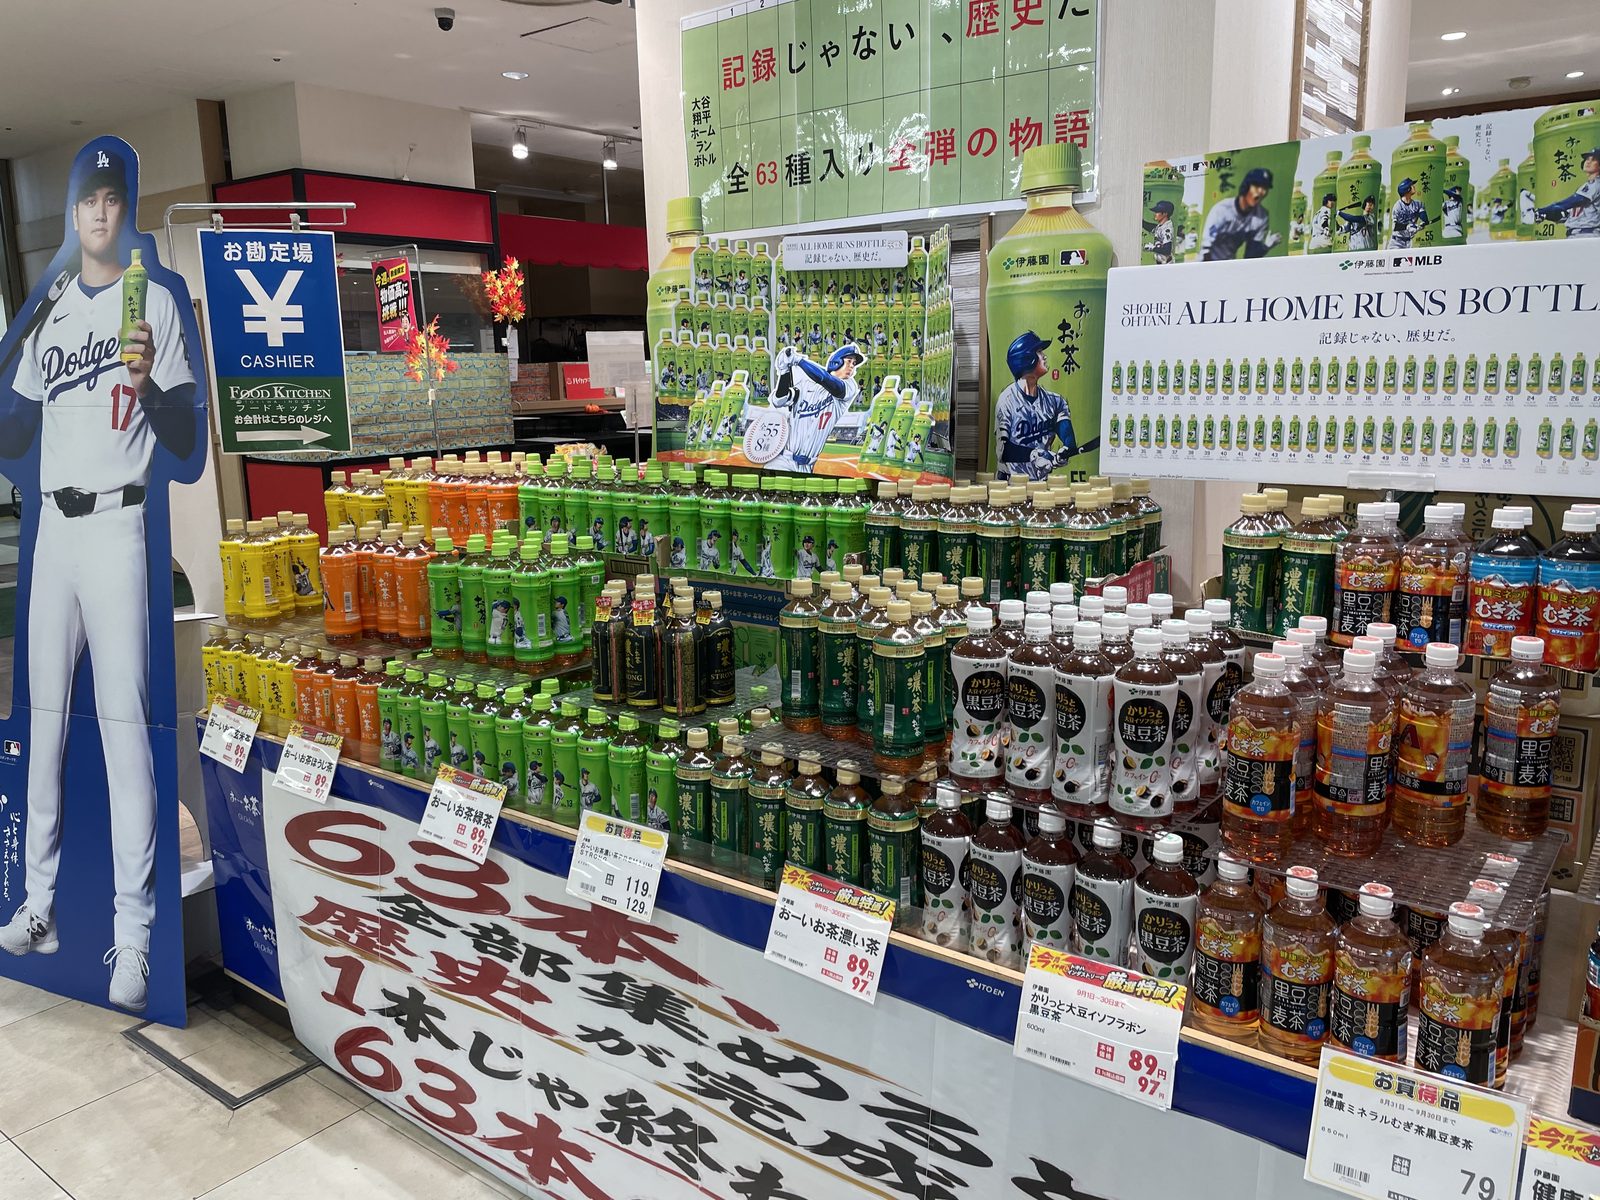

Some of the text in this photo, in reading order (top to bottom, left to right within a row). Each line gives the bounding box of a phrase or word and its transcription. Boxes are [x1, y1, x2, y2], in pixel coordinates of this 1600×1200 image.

[692, 96, 711, 111] 大谷
[692, 110, 711, 126] 翔平
[690, 125, 716, 139] ホーム
[696, 140, 713, 153] ラン
[693, 152, 717, 167] ボトル
[1543, 224, 1555, 237] 20
[223, 241, 314, 264] お勘定場
[1015, 254, 1050, 268] 伊藤園
[1354, 255, 1443, 269] 伊藤園 MLB
[1122, 302, 1172, 315] SHOHEI
[1176, 283, 1600, 325] ALL HOME RUNS BOTTL
[1121, 314, 1171, 327] OHTANI
[1318, 328, 1457, 345] 記録じゃない、歴史だ。
[42, 331, 121, 392] Dodge
[240, 355, 315, 368] CASHIER
[229, 385, 332, 400] FOOD KITCHEN
[110, 383, 137, 432] 17
[235, 403, 327, 412] フードキッチン
[234, 414, 332, 425] お会計はこちらのレジへ
[818, 411, 833, 430] 17
[1029, 552, 1048, 591] 濃い茶
[1349, 573, 1386, 589] むぎ茶
[1231, 563, 1254, 608] 濃い茶
[1283, 567, 1304, 614] 濃い茶
[1342, 591, 1371, 613] 黒豆
[1475, 598, 1525, 622] むぎ茶
[1542, 603, 1592, 628] むぎ茶
[1127, 704, 1163, 718] かりっと
[1122, 723, 1168, 742] 黒豆茶
[1230, 735, 1266, 757] むぎ茶
[1518, 765, 1549, 785] 麦茶
[431, 795, 494, 829] おーいお茶緑茶
[759, 811, 778, 852] 濃い茶
[830, 833, 850, 876] 濃い茶
[869, 842, 886, 887] 濃い茶
[779, 905, 881, 956] おーいお茶濃い茶
[1144, 913, 1182, 930] かりっと
[1139, 933, 1186, 953] 黒豆茶
[1200, 935, 1234, 958] むぎ茶
[1281, 962, 1323, 981] むぎ茶
[978, 983, 1005, 998] ITO EN
[1103, 971, 1178, 1003] 厳選特価!
[1274, 979, 1307, 1006] 黒豆
[1029, 1004, 1061, 1023] 黒豆茶
[1030, 992, 1147, 1035] かりっと大豆イソフラボン
[1272, 1005, 1305, 1031] 麦茶
[1423, 994, 1462, 1023] むぎ茶
[1026, 1022, 1045, 1034] 600ml
[1373, 1070, 1463, 1113] お買得品
[1323, 1097, 1474, 1151] 健康ミネラルむぎ茶黒豆麦茶
